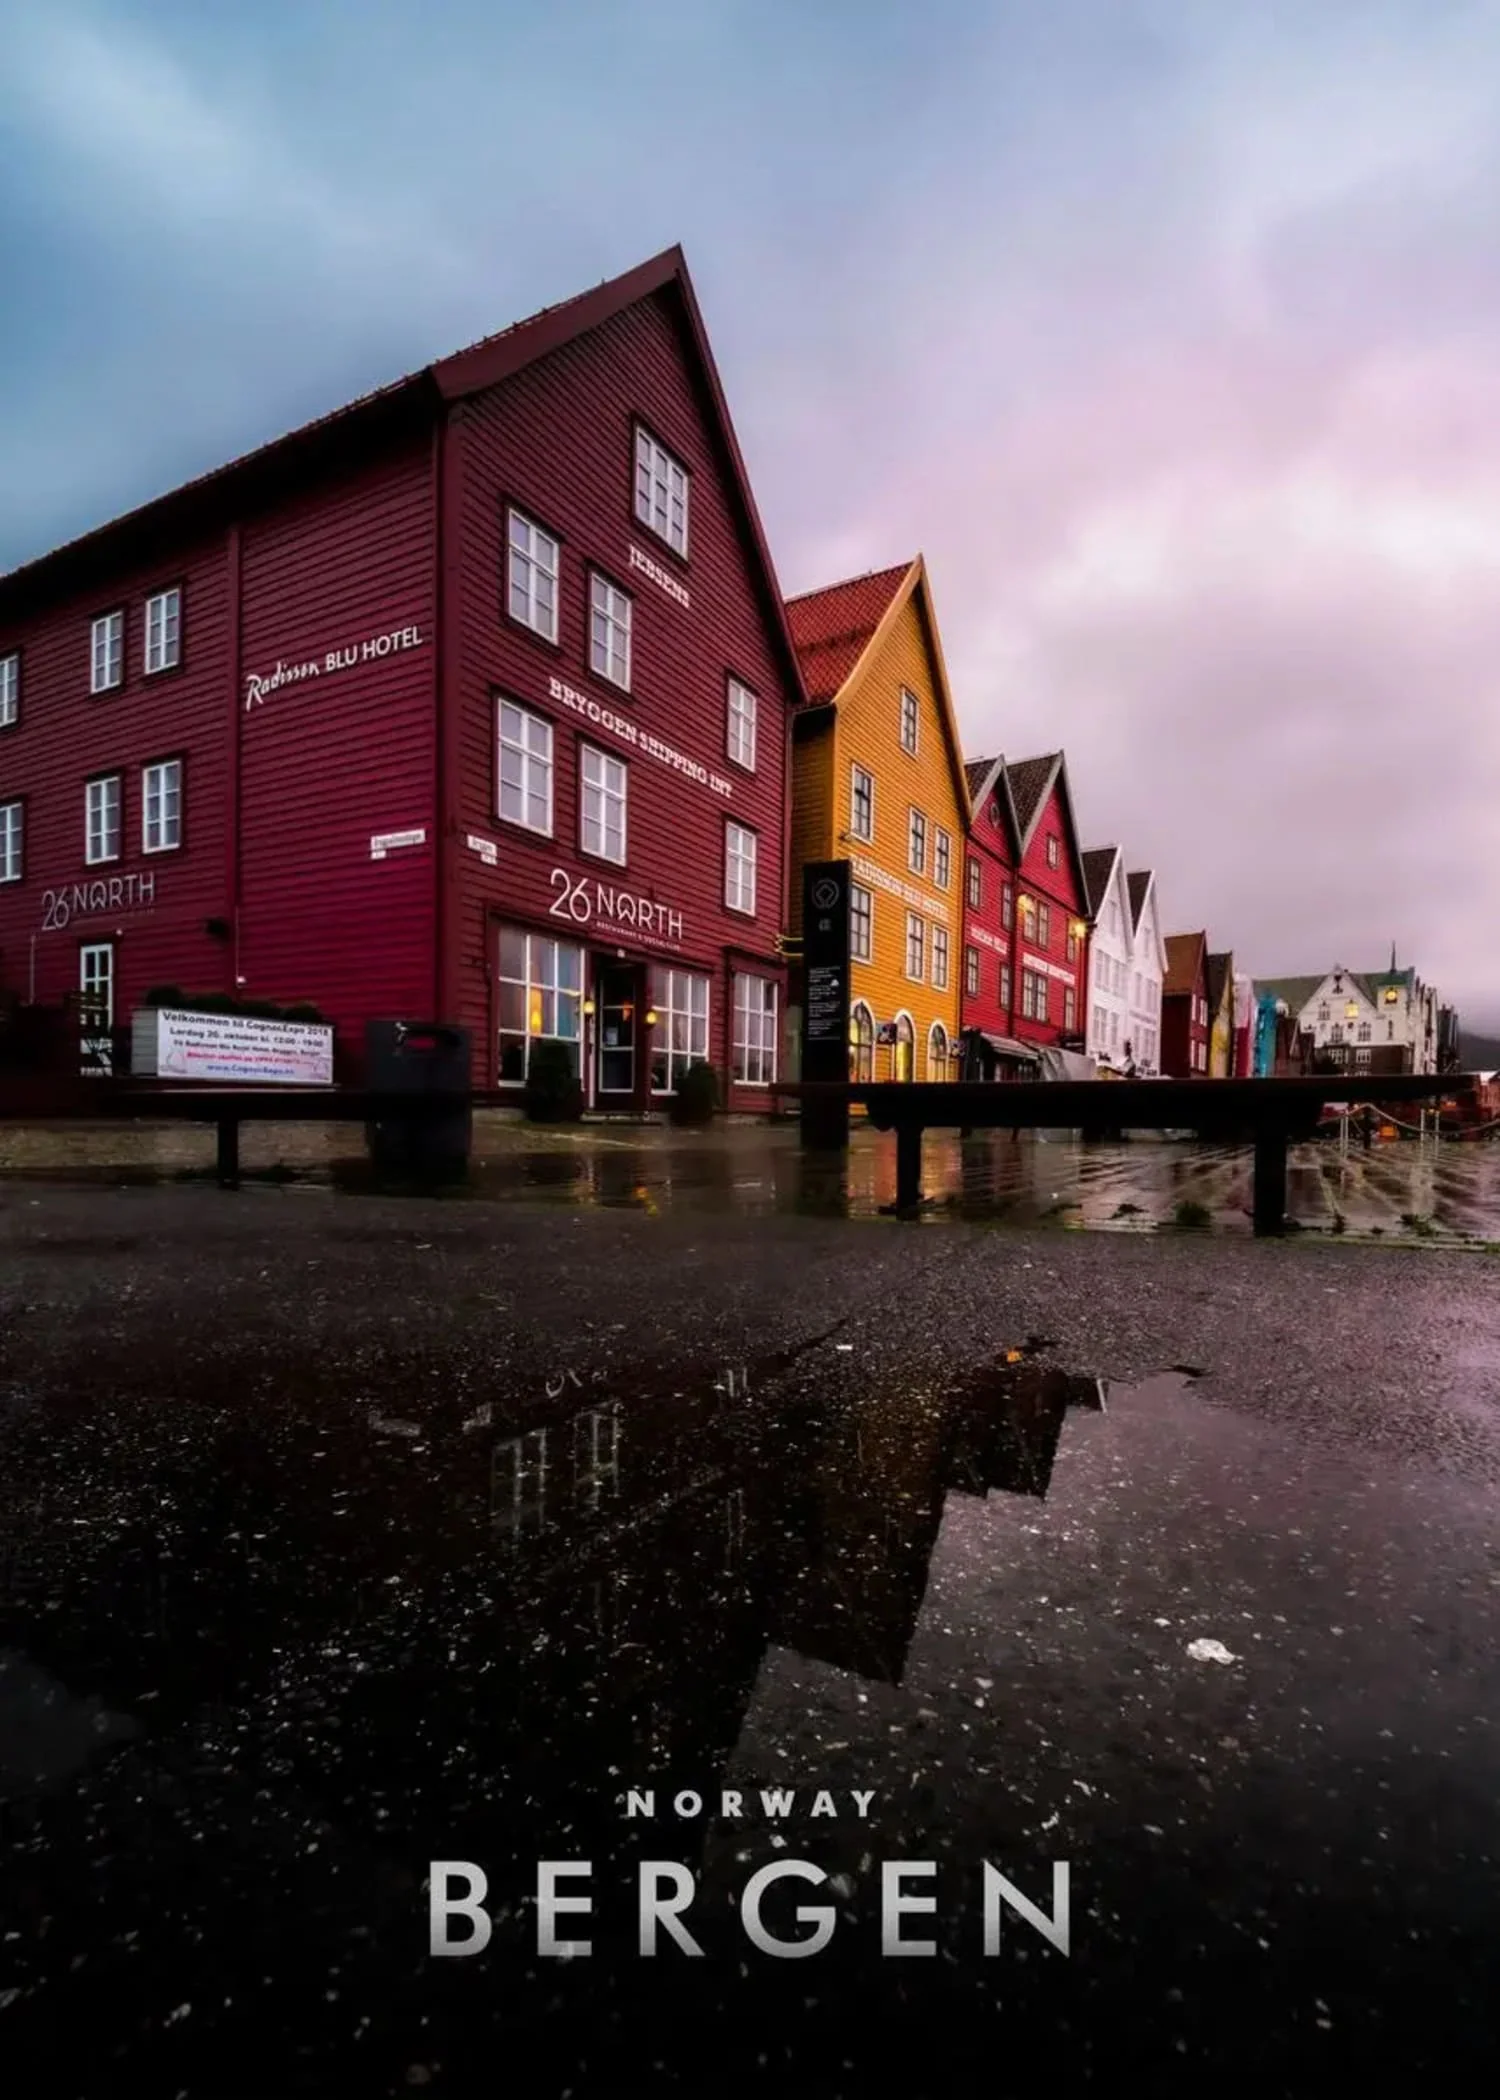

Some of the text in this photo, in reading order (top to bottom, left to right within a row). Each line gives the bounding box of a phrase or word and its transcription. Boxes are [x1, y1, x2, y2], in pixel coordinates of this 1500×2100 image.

[245, 626, 423, 712] Radisson BLU HOTEL
[549, 676, 638, 744] BRYGGEN
[639, 732, 708, 785] SHIPPING
[41, 884, 70, 931] 26
[549, 868, 592, 922] 26
[163, 1011, 230, 1026] Velkommen
